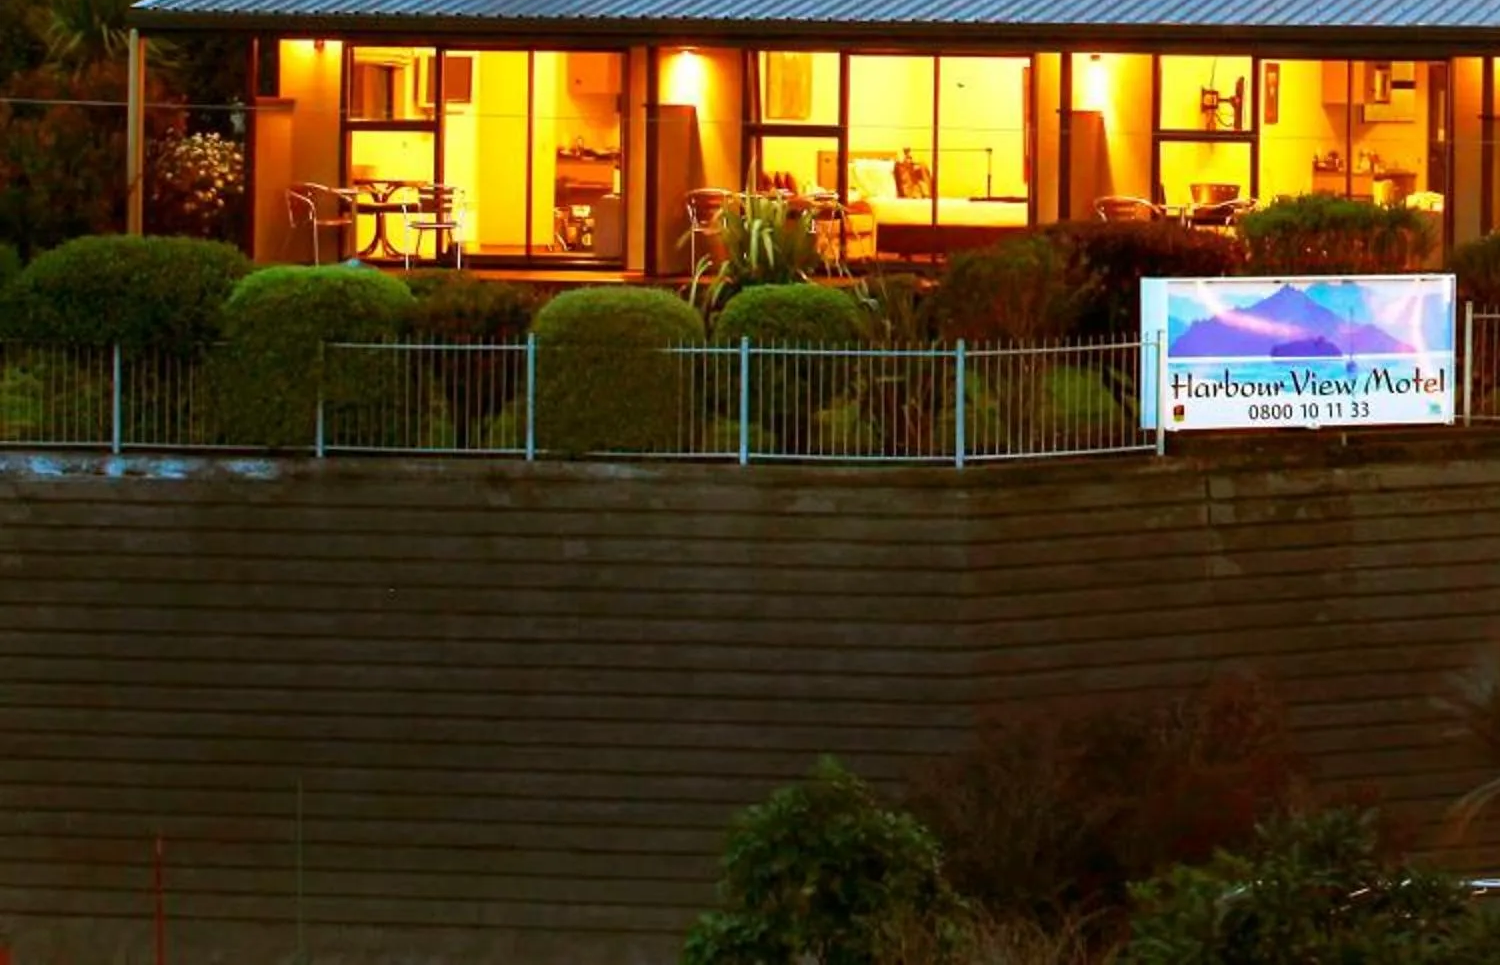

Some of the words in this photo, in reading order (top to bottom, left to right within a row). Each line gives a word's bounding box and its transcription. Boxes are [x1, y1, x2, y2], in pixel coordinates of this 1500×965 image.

[1170, 368, 1285, 399] Harbour
[1290, 369, 1357, 396] View
[1363, 367, 1445, 396] Motel
[1248, 404, 1293, 420] 0800
[1300, 403, 1319, 419] 10
[1327, 402, 1343, 419] 11
[1350, 402, 1370, 418] 33
